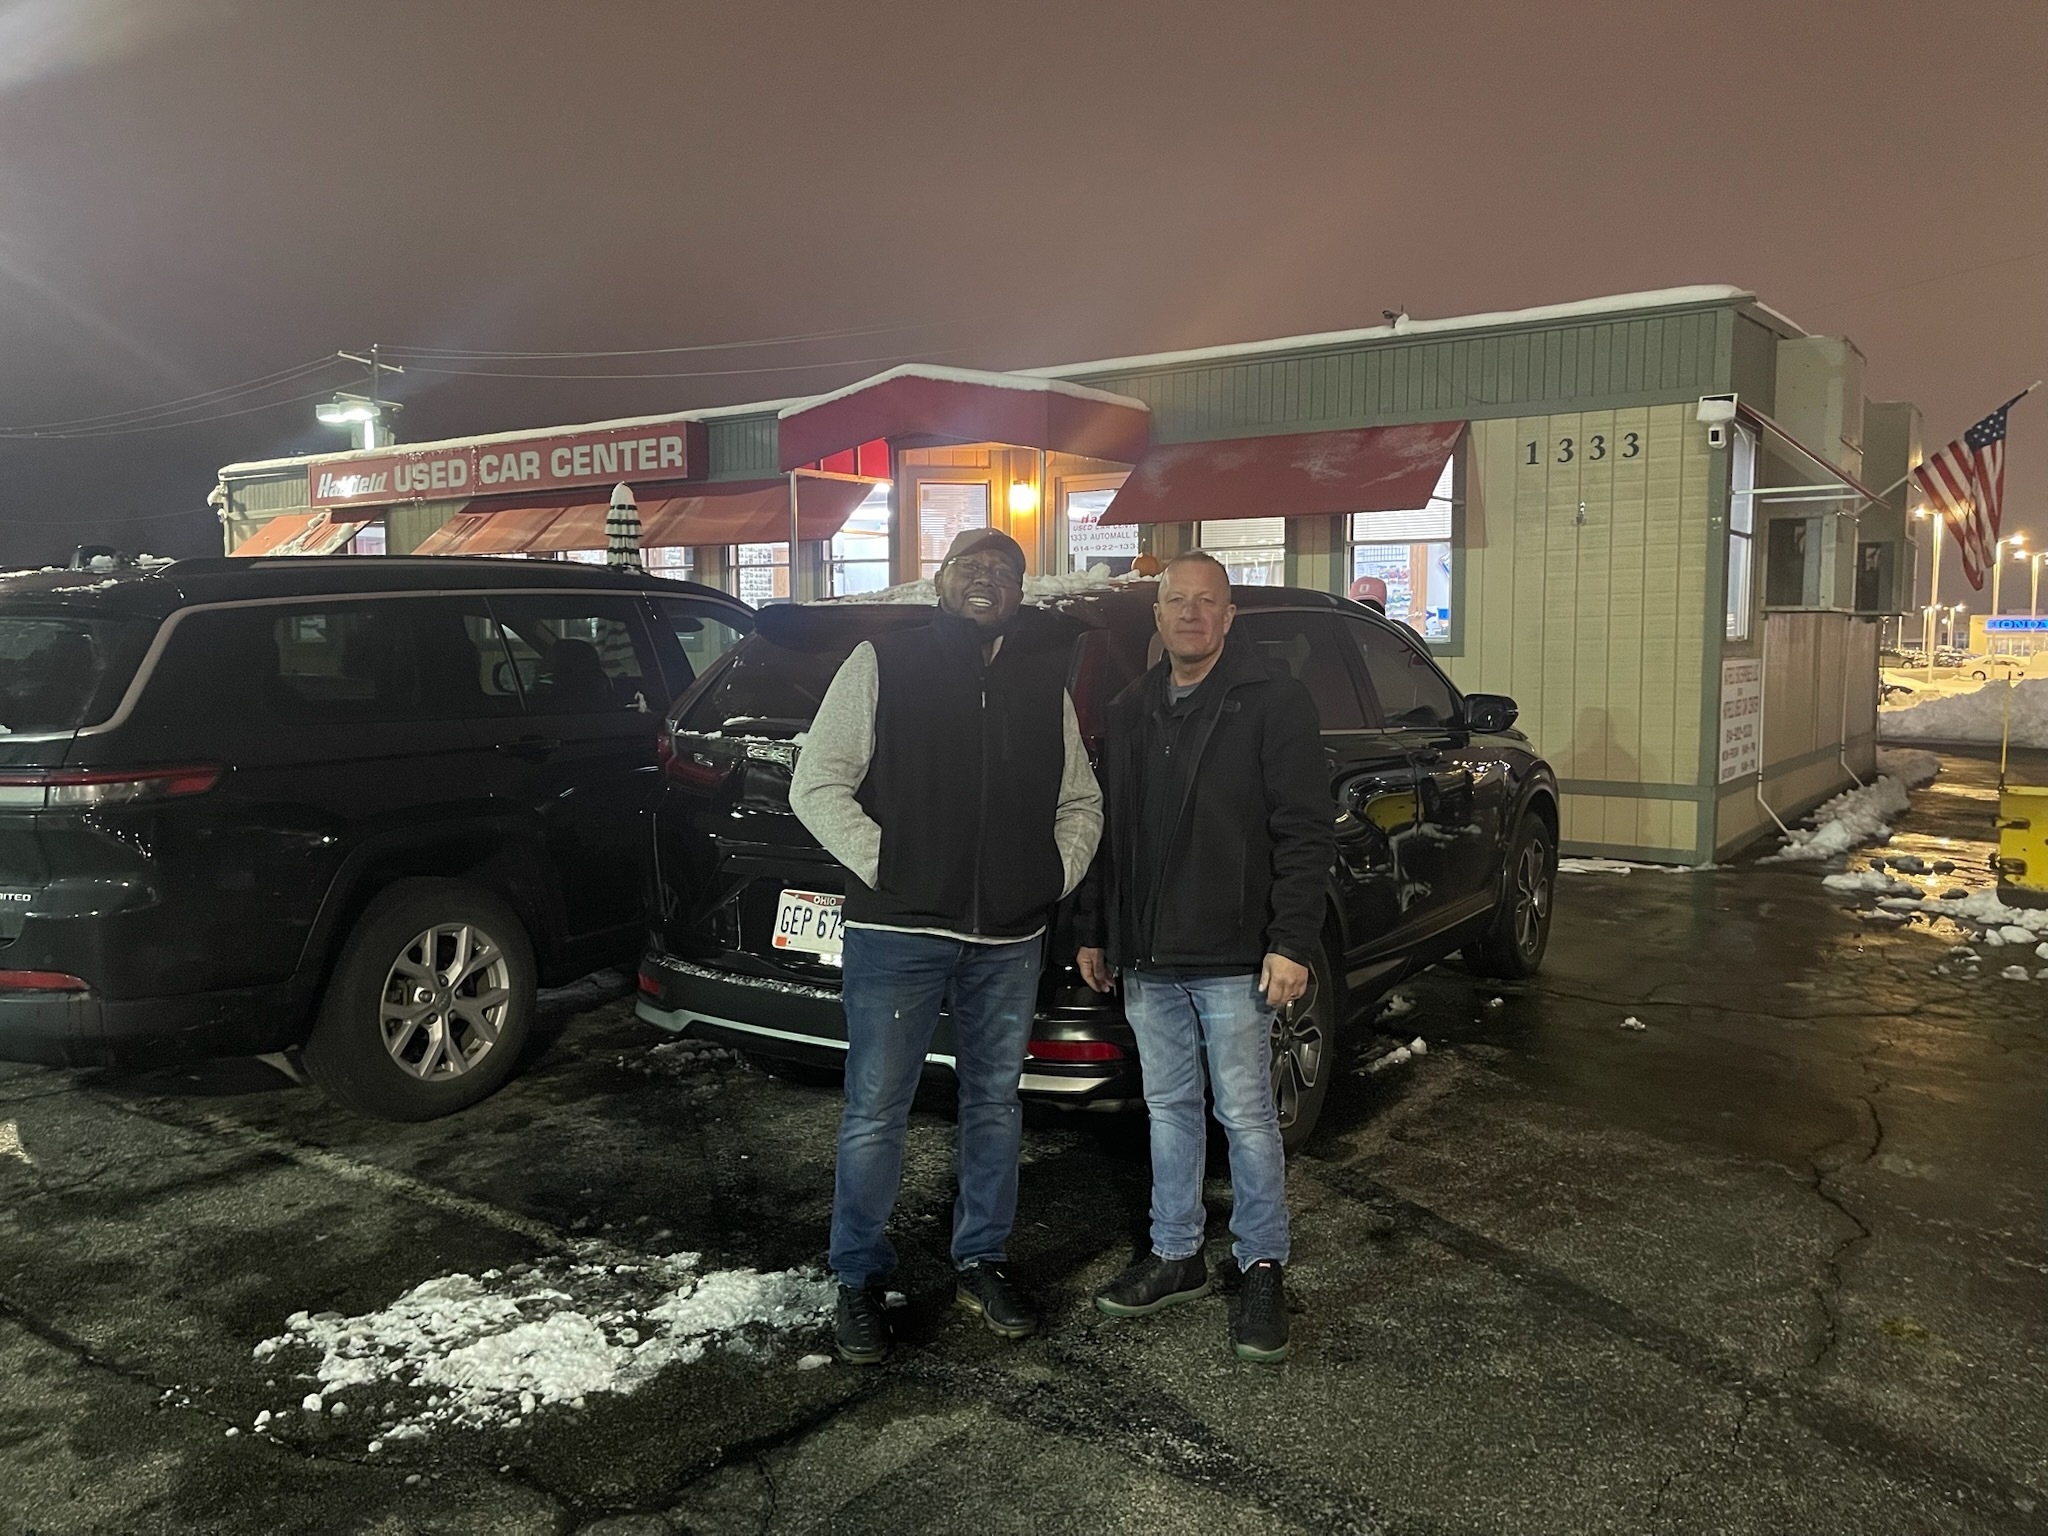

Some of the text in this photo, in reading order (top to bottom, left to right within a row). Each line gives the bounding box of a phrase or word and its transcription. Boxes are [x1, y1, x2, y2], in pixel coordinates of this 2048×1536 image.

[1526, 432, 1640, 465] 1333
[316, 436, 683, 498] Hatfield USED CAR CENTER
[1071, 533, 1088, 542] 1333
[1090, 531, 1130, 541] AUTOMALL
[1073, 543, 1139, 553] 614-922-133
[813, 895, 837, 906] OHIO
[780, 905, 813, 936] GEP
